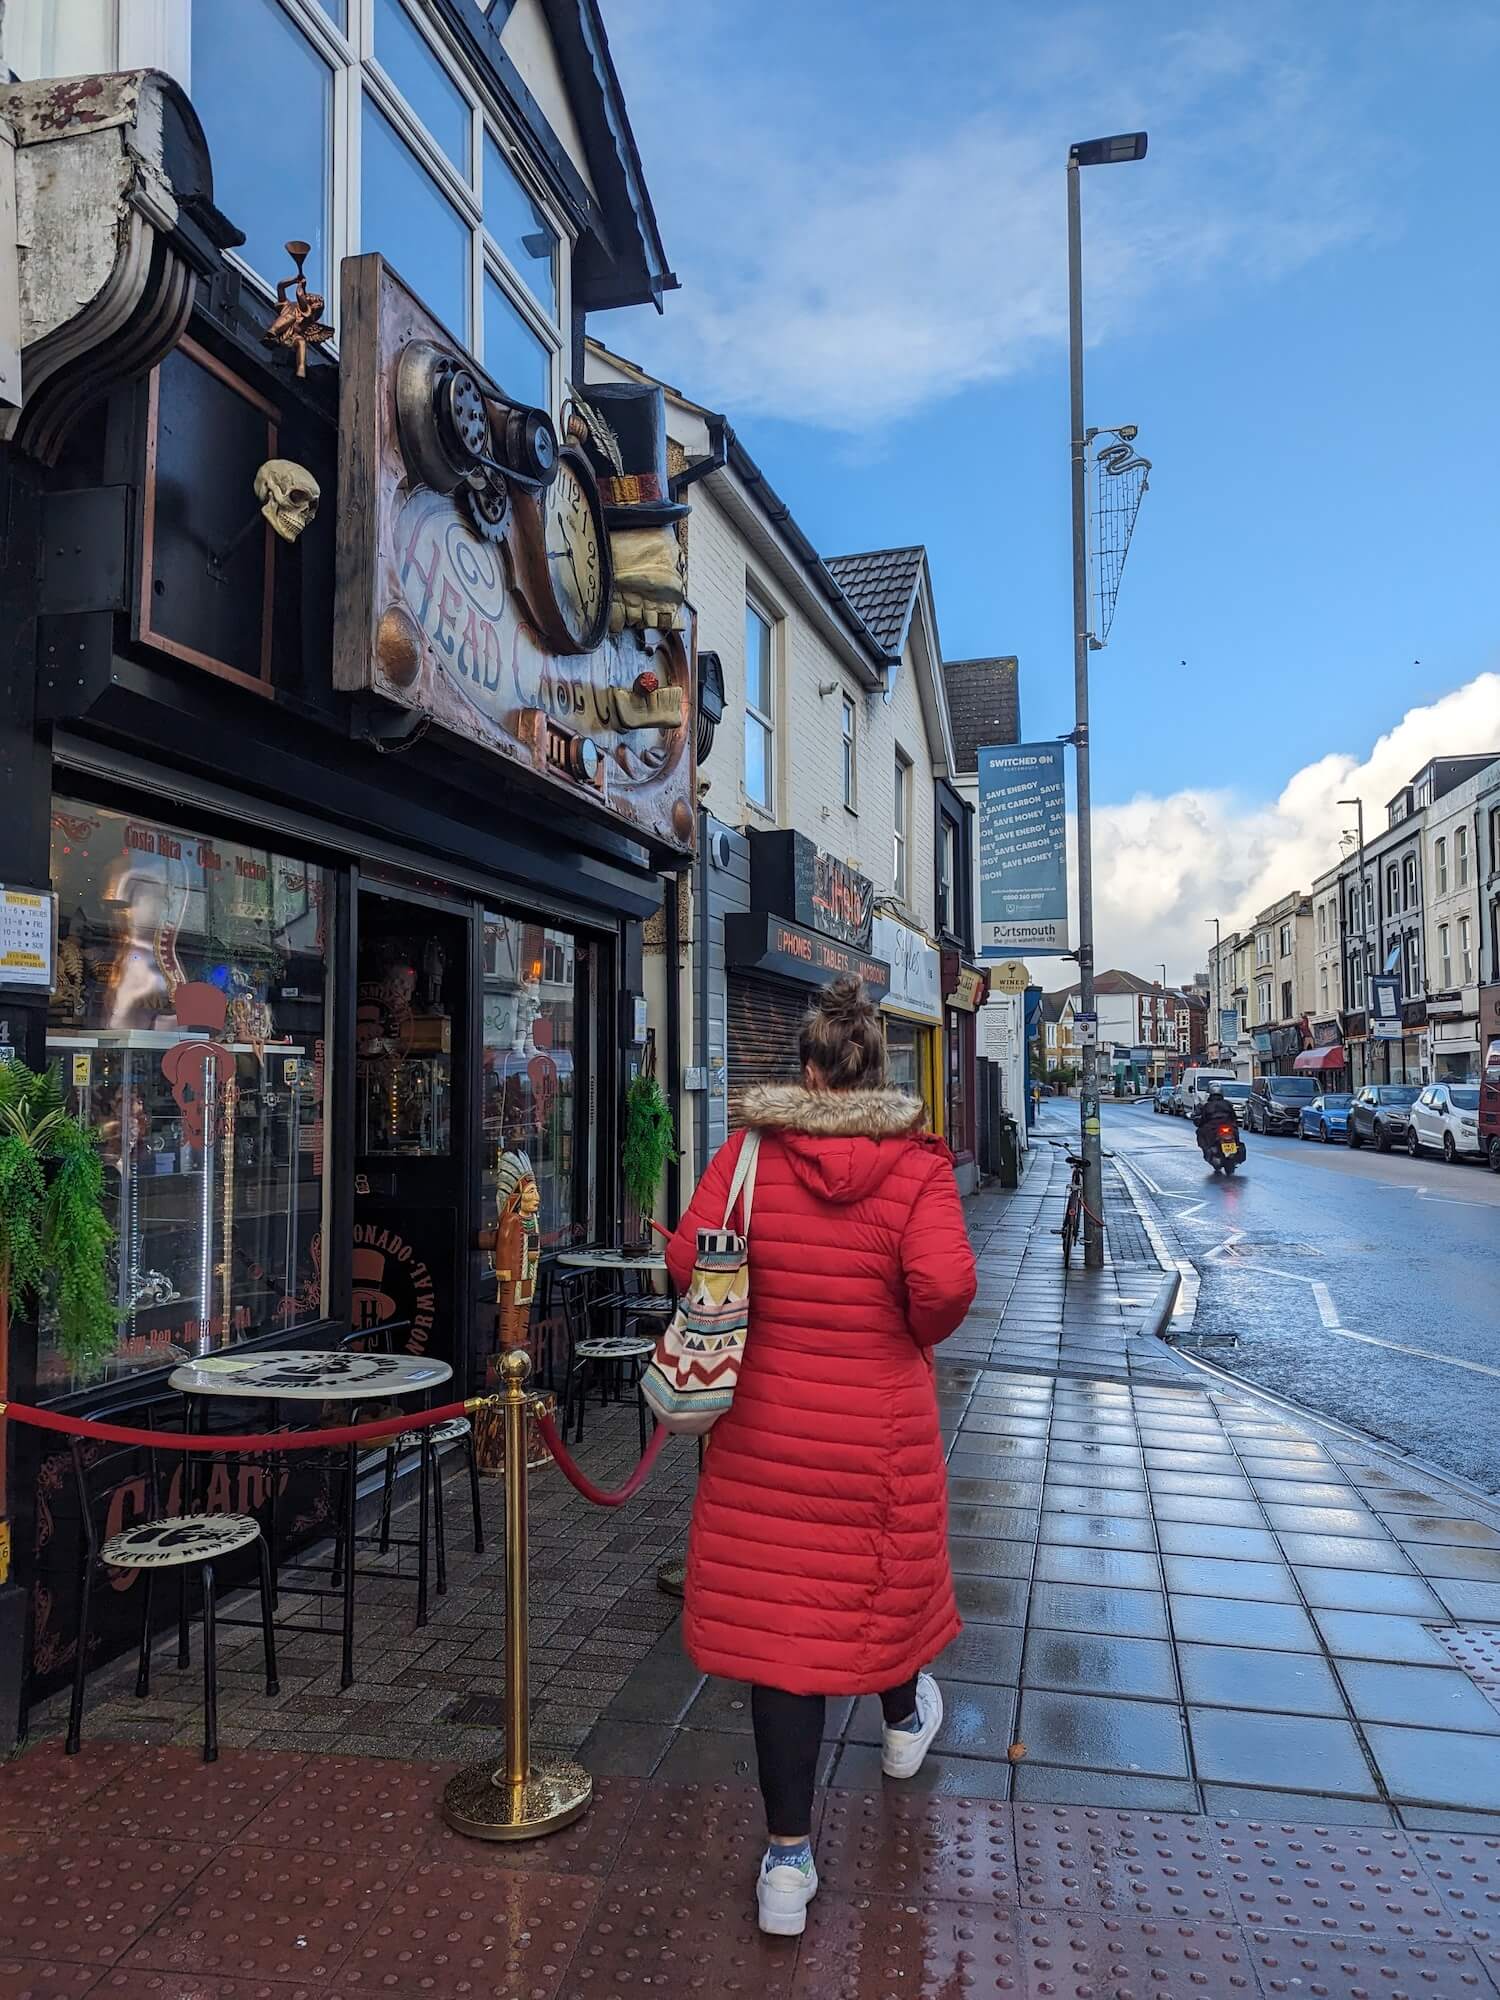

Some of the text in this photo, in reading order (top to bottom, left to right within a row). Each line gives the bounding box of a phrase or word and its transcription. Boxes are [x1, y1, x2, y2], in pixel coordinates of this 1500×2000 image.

[582, 510, 588, 537] 1
[587, 541, 597, 571] 2
[587, 576, 597, 604] 3
[989, 755, 1053, 768] SWITCHED ON
[986, 781, 1038, 800] SAVE ENERGY
[1040, 783, 1060, 794] SAVE
[986, 796, 1041, 814] SAVE CARBON
[993, 810, 1044, 827] SAVE MONEY
[994, 824, 1046, 841] SAVE ENERGY
[995, 838, 1050, 856] SAVE CARBON
[1002, 852, 1052, 869] SAVE MONEY
[993, 923, 1056, 937] Portsmouth
[783, 931, 812, 961] PHONES
[822, 945, 849, 972] TABLETS
